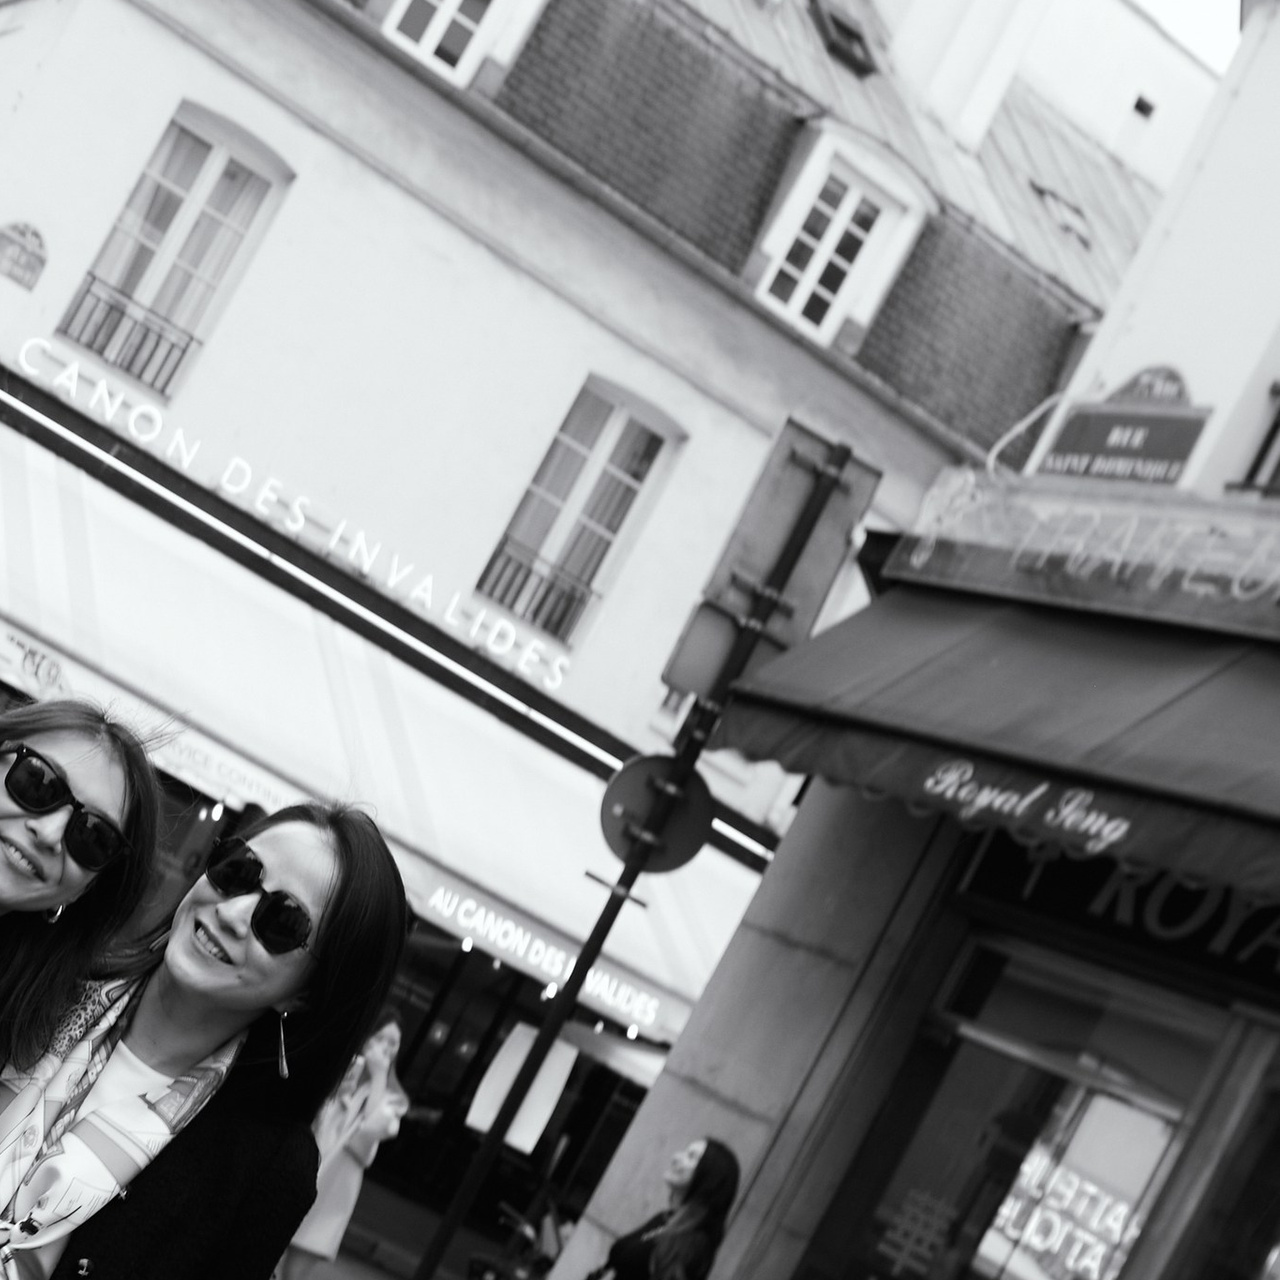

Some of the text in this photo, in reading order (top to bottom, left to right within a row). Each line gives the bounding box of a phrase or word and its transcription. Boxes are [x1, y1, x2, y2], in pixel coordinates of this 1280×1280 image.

[19, 336, 202, 470] CANON
[221, 456, 311, 533] DES
[328, 518, 571, 690] INVALIDES
[923, 758, 1050, 819] Royal
[428, 885, 660, 1027] AU CANON DES IVALIDES
